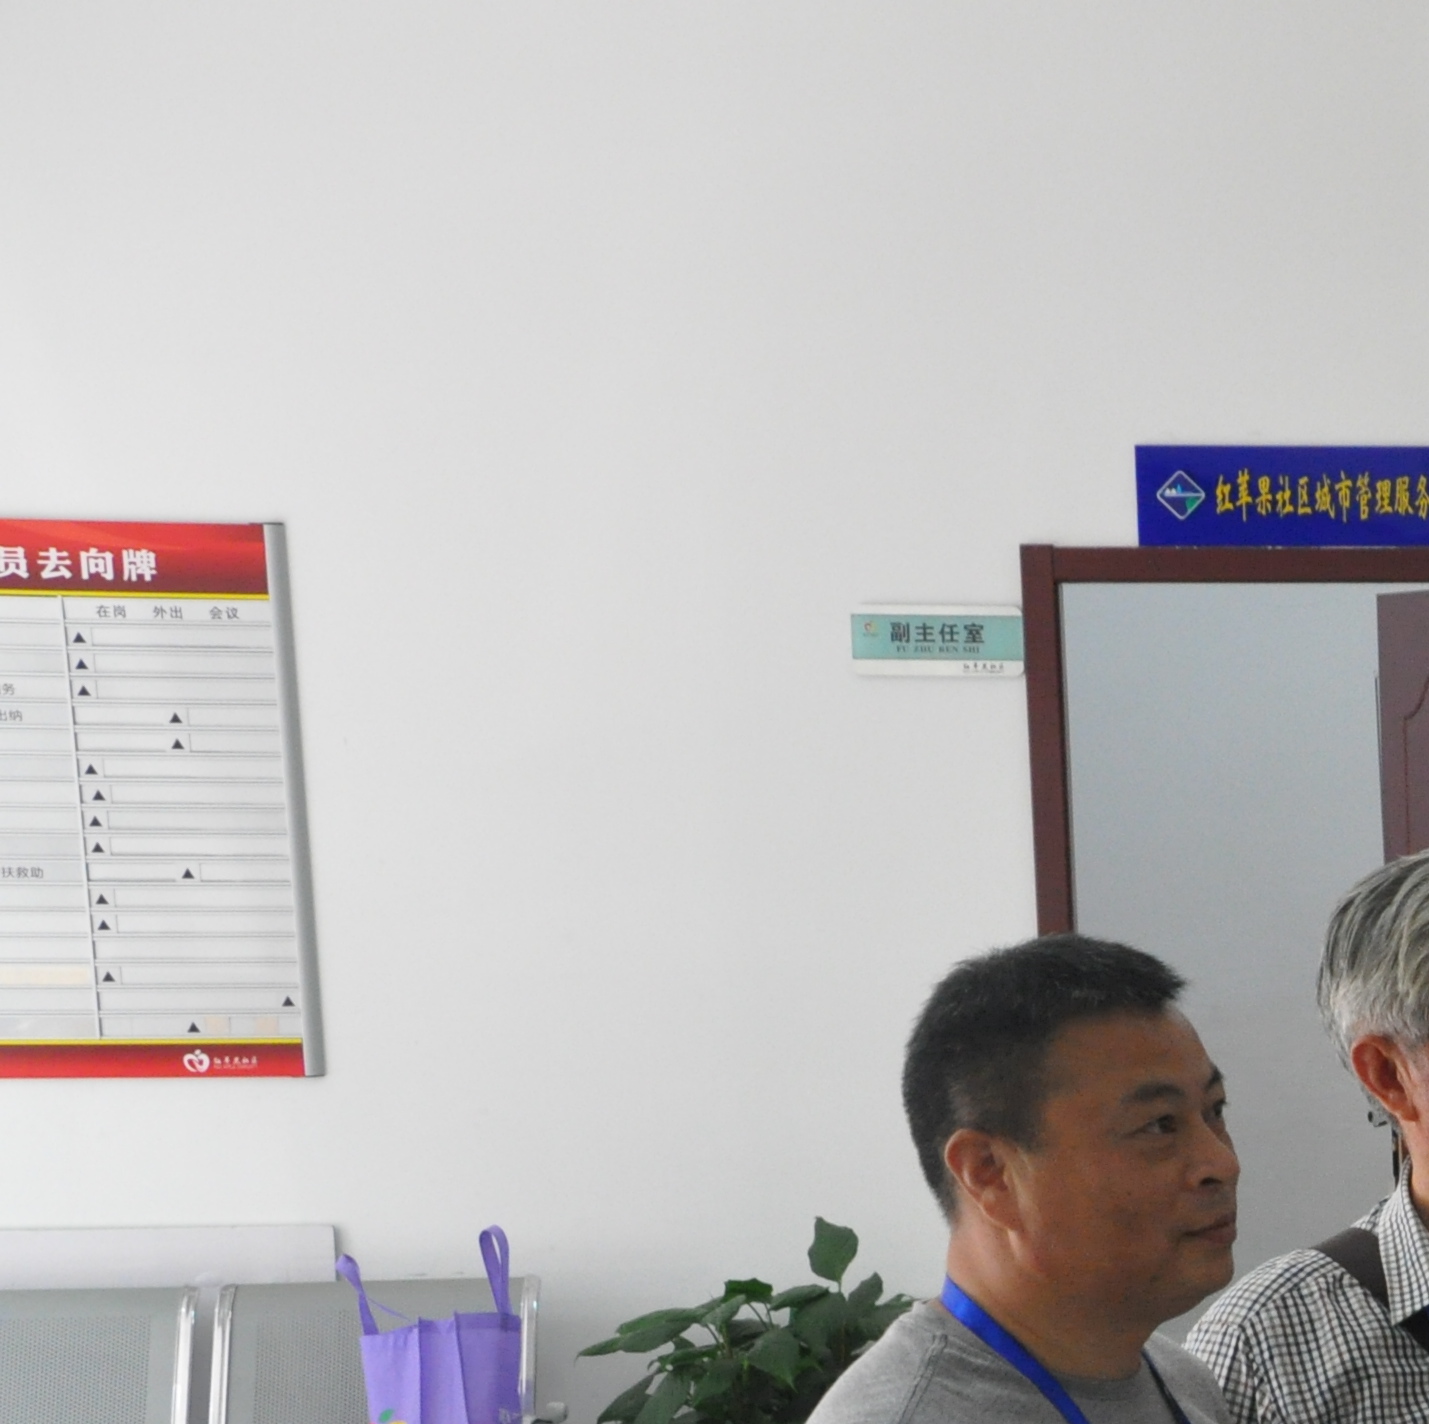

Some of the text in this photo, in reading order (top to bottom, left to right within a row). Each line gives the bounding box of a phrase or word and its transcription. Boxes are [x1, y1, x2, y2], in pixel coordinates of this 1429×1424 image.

[0, 546, 158, 582] 员去向牌
[96, 605, 240, 620] 在岗 外出 会议
[890, 622, 985, 644] 副主任室
